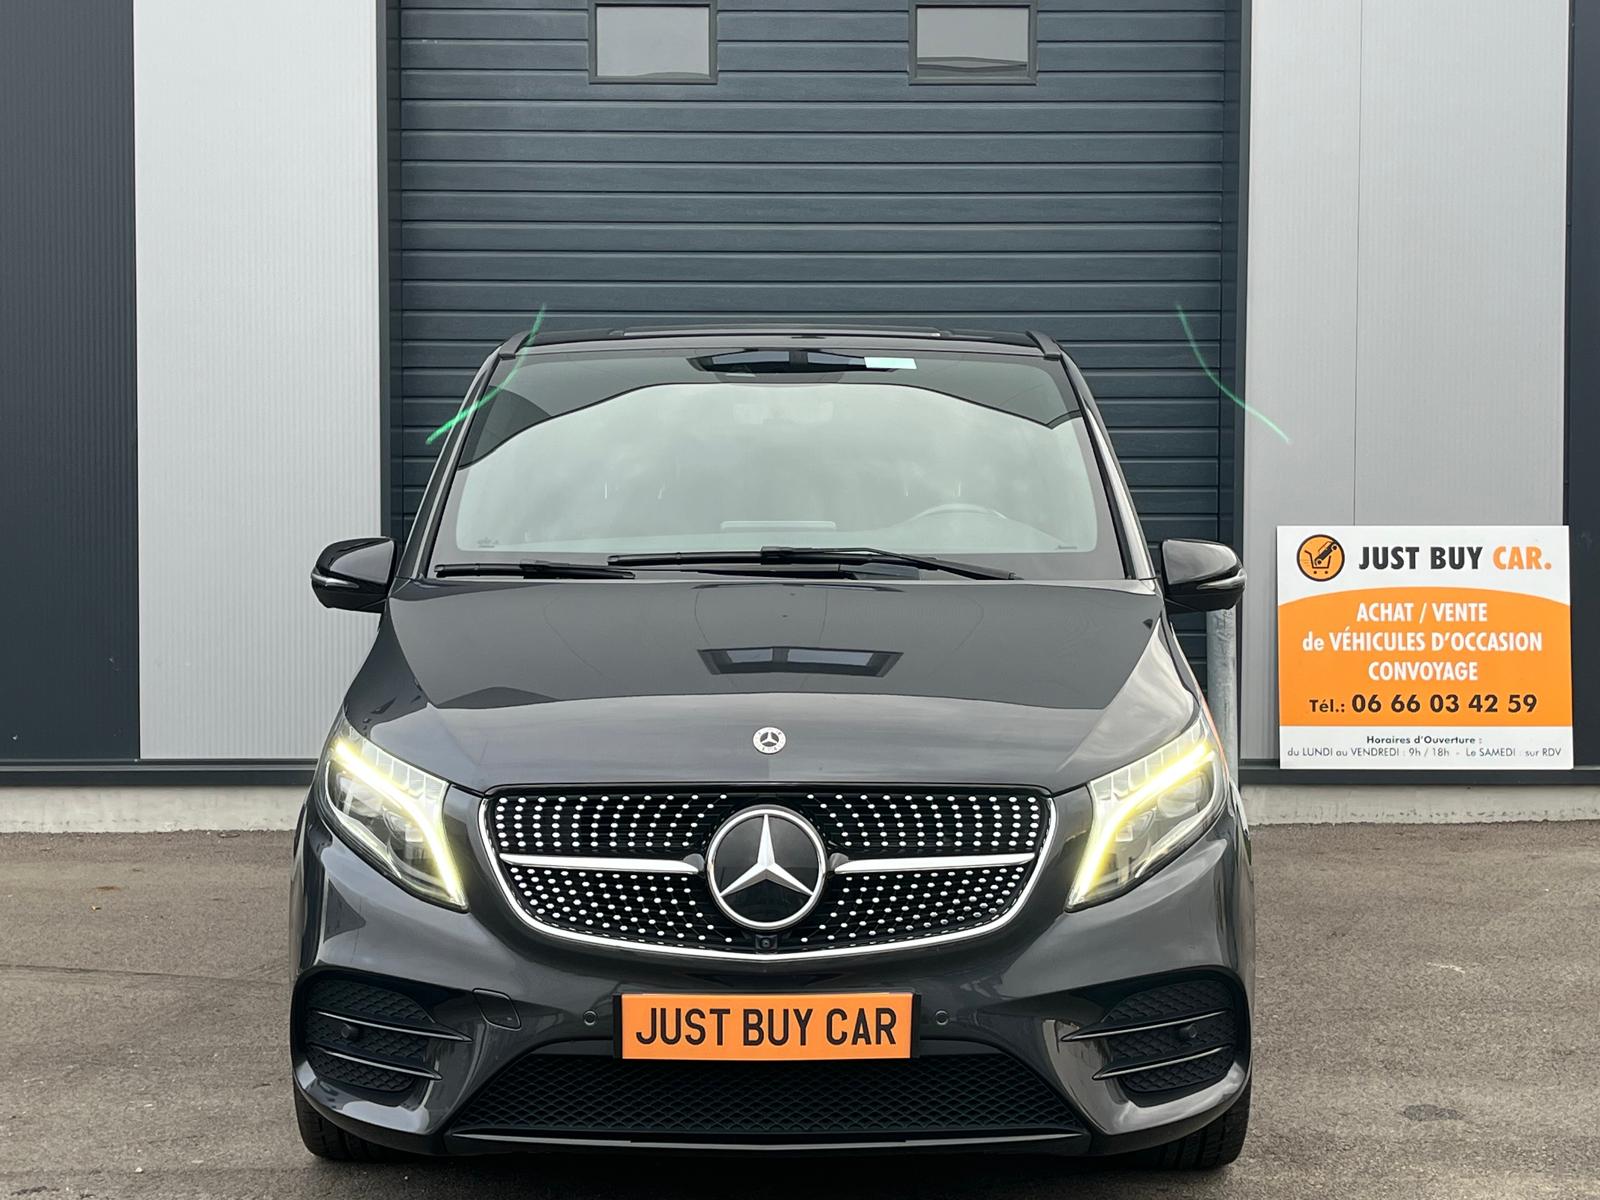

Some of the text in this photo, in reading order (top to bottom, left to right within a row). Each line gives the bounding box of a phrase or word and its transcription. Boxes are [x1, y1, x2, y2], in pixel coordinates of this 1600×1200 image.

[1359, 547, 1552, 569] JUST BUY CAR.
[1356, 603, 1414, 622] ACHAT
[1432, 603, 1488, 622] VENTE
[1302, 627, 1543, 652] de VÉHICULES D'OCCASION
[1368, 661, 1479, 681] CONVOYAGE
[1309, 694, 1538, 713] Tél.: 06 66 03 42 59
[1366, 735, 1411, 745] Horaires
[1287, 747, 1300, 757] du
[1302, 747, 1333, 757] LUNDI
[1350, 747, 1400, 757] VENDREDI
[1408, 747, 1422, 757] 9h
[1433, 747, 1450, 758] 18h
[1465, 747, 1477, 757] Le
[1479, 747, 1516, 757] SAMEDI
[1542, 747, 1562, 757] RDV
[635, 1007, 897, 1046] JUST BUY CAR
